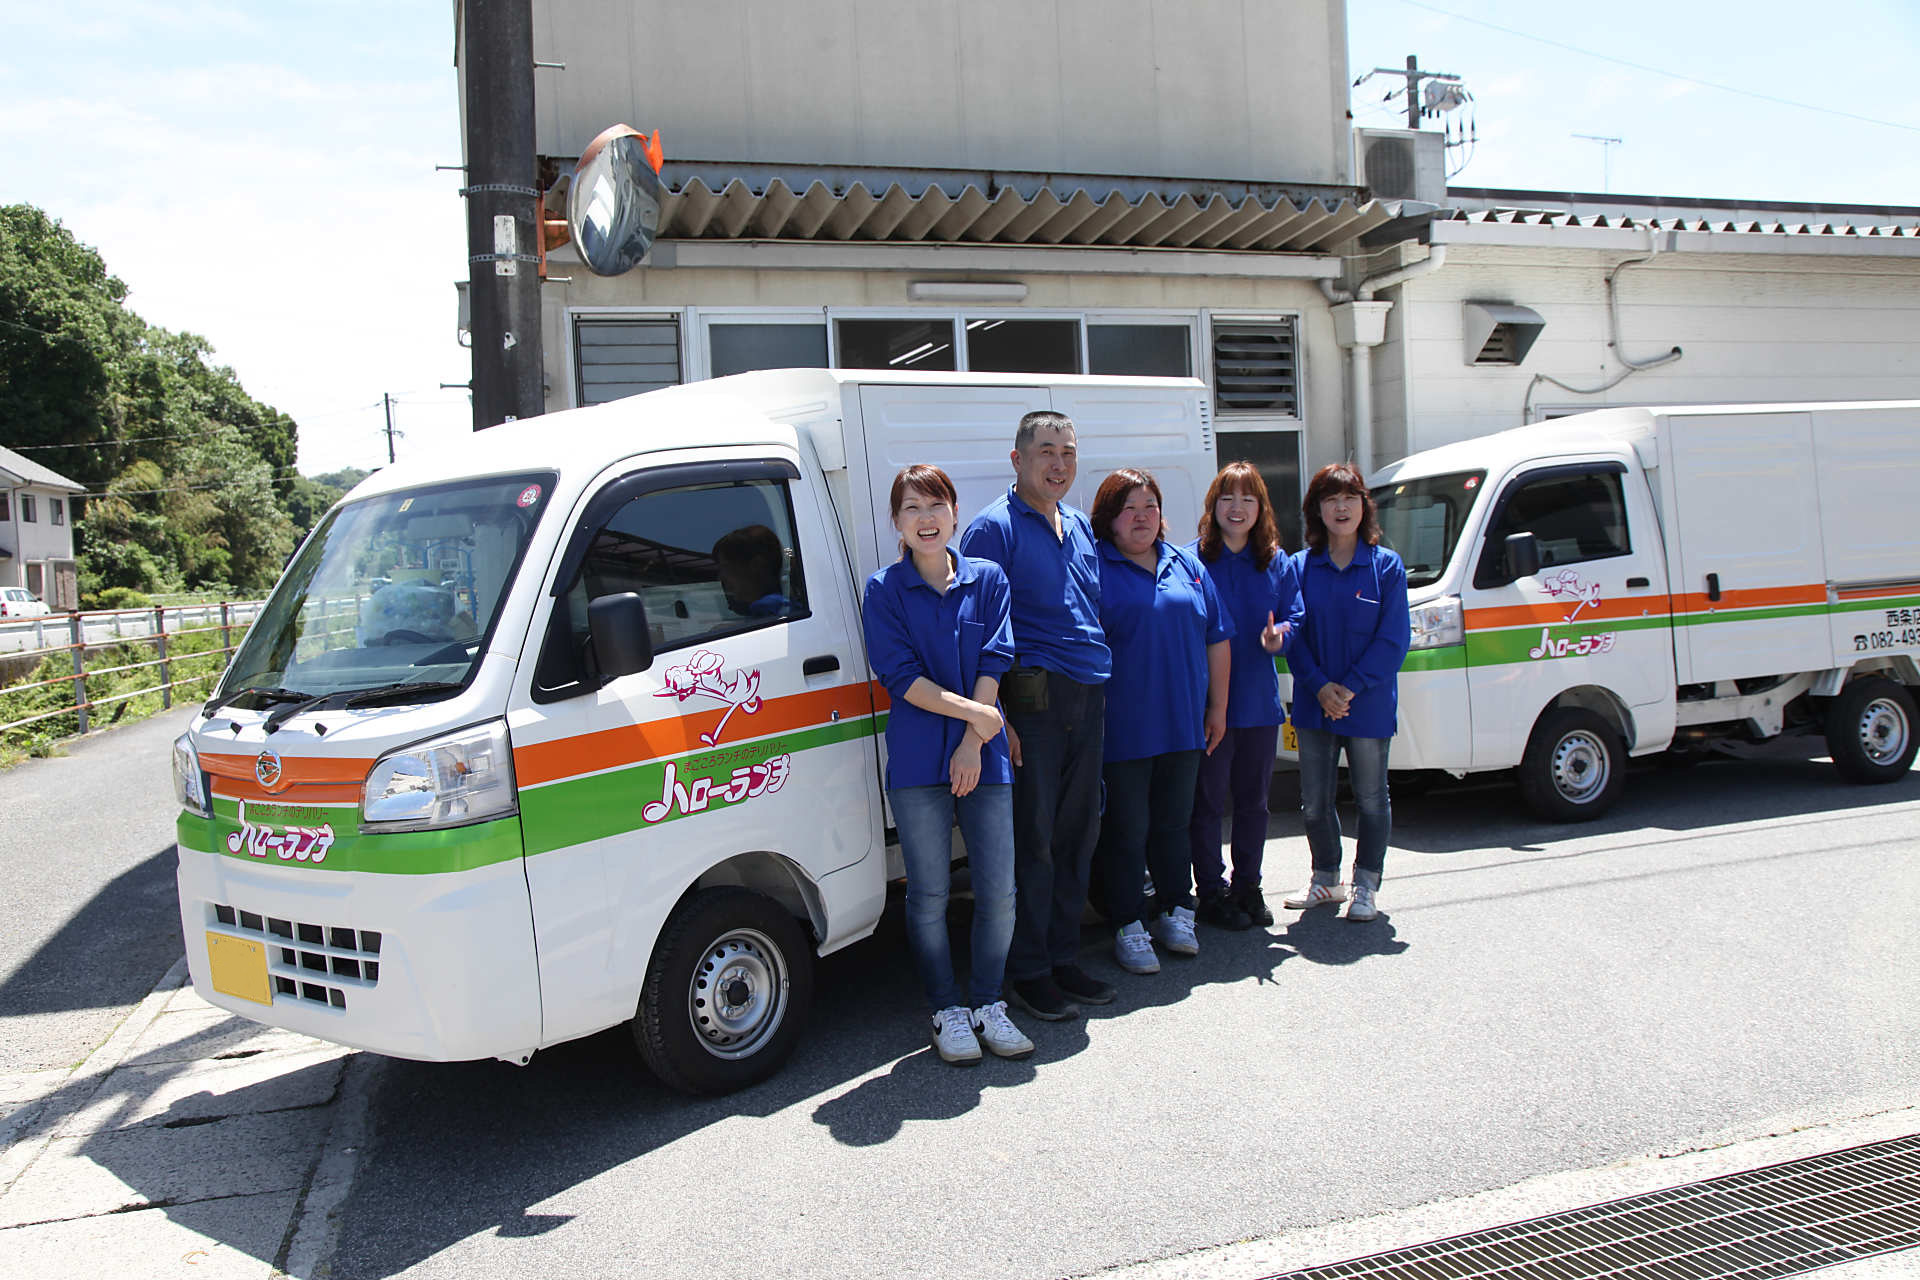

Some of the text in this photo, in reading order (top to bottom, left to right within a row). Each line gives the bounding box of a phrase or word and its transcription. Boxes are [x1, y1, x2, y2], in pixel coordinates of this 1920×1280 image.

[1529, 627, 1617, 660] ハローランチ
[642, 753, 790, 823] ハローランチ
[227, 798, 335, 863] ハローランチ
